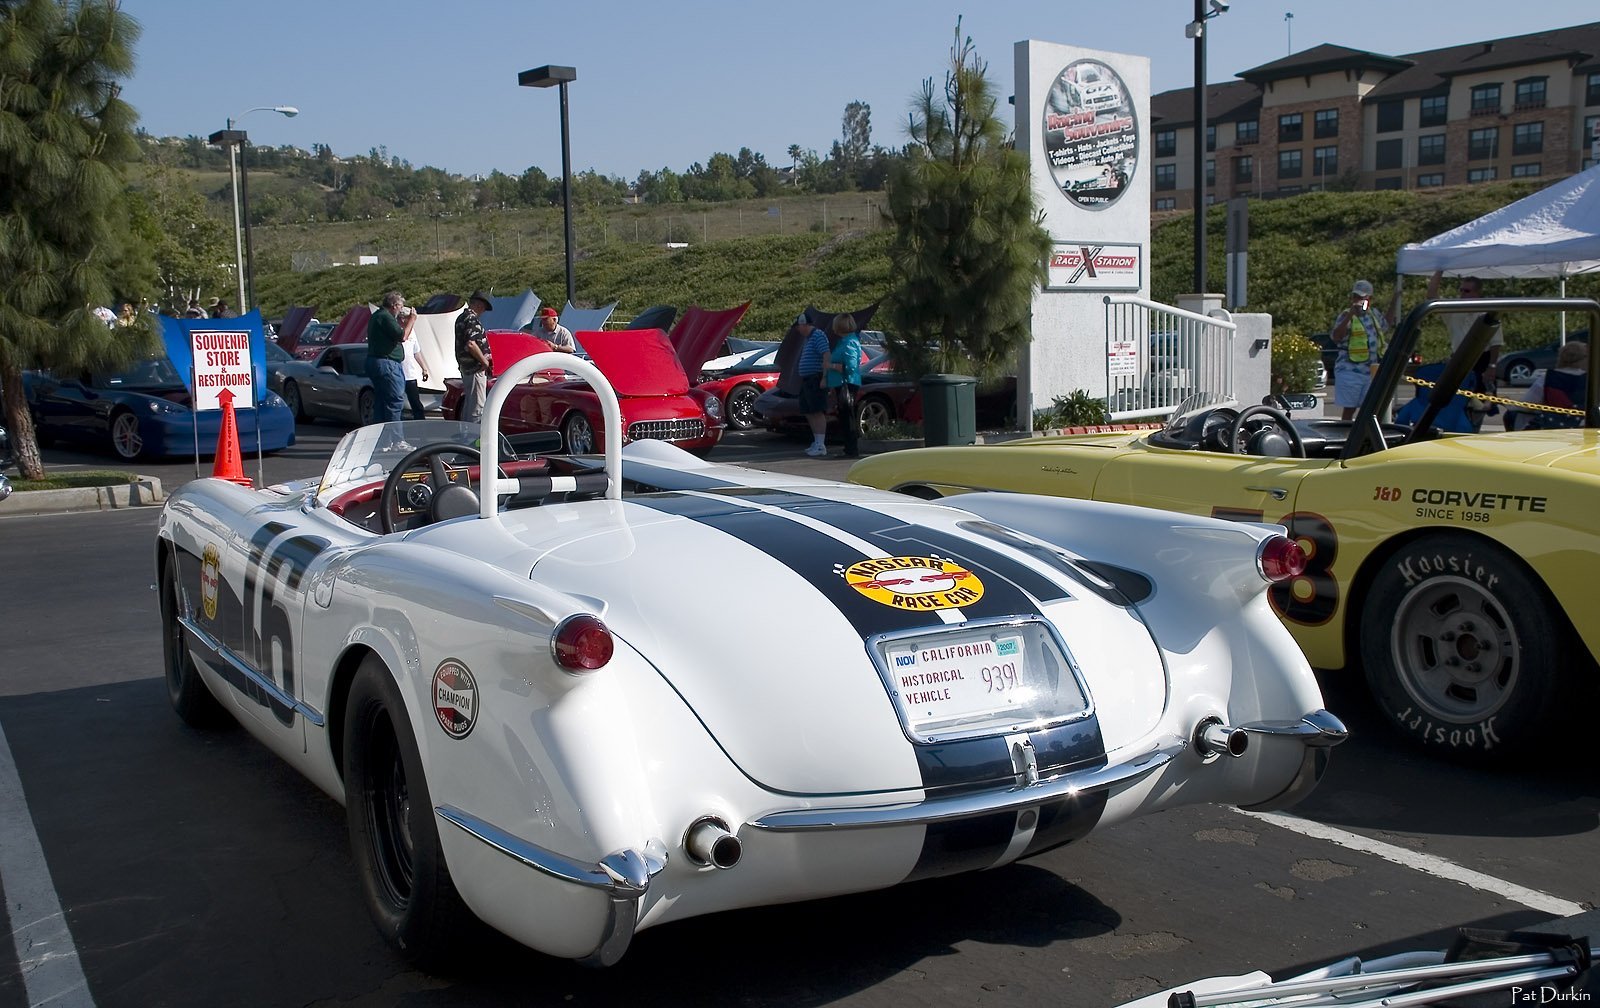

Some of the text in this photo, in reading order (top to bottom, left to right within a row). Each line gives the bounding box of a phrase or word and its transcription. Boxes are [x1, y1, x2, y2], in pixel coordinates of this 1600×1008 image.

[1048, 108, 1094, 130] Racing
[1065, 115, 1132, 142] Souvenirs
[1048, 134, 1136, 158] T-shirts Hats Jackets Toys
[1052, 142, 1134, 166] Videos Diecast Collectibles
[1100, 154, 1114, 163] Auto
[1115, 152, 1124, 161] Art
[1055, 255, 1080, 265] RACE
[1096, 256, 1132, 266] STATION
[195, 334, 248, 350] SOUVENIR
[207, 351, 240, 367] STORE
[198, 373, 250, 387] RESTROOMS
[1373, 486, 1548, 512] J&D CORVETTE
[1415, 507, 1490, 523] SINCE 1958
[849, 556, 944, 578] NASCAR
[1397, 553, 1499, 588] Hoosier
[891, 587, 979, 609] RACE CAR
[896, 642, 1013, 667] NOV CALIFORNIA 2007
[440, 666, 472, 688] EQUIPPED WITH
[901, 662, 1020, 693] HISTORICAL 9391
[438, 687, 470, 710] CHAMPION
[905, 688, 951, 705] VEHICLE
[440, 711, 468, 731] SPARK PLUGS
[1397, 707, 1500, 750] Hoosier
